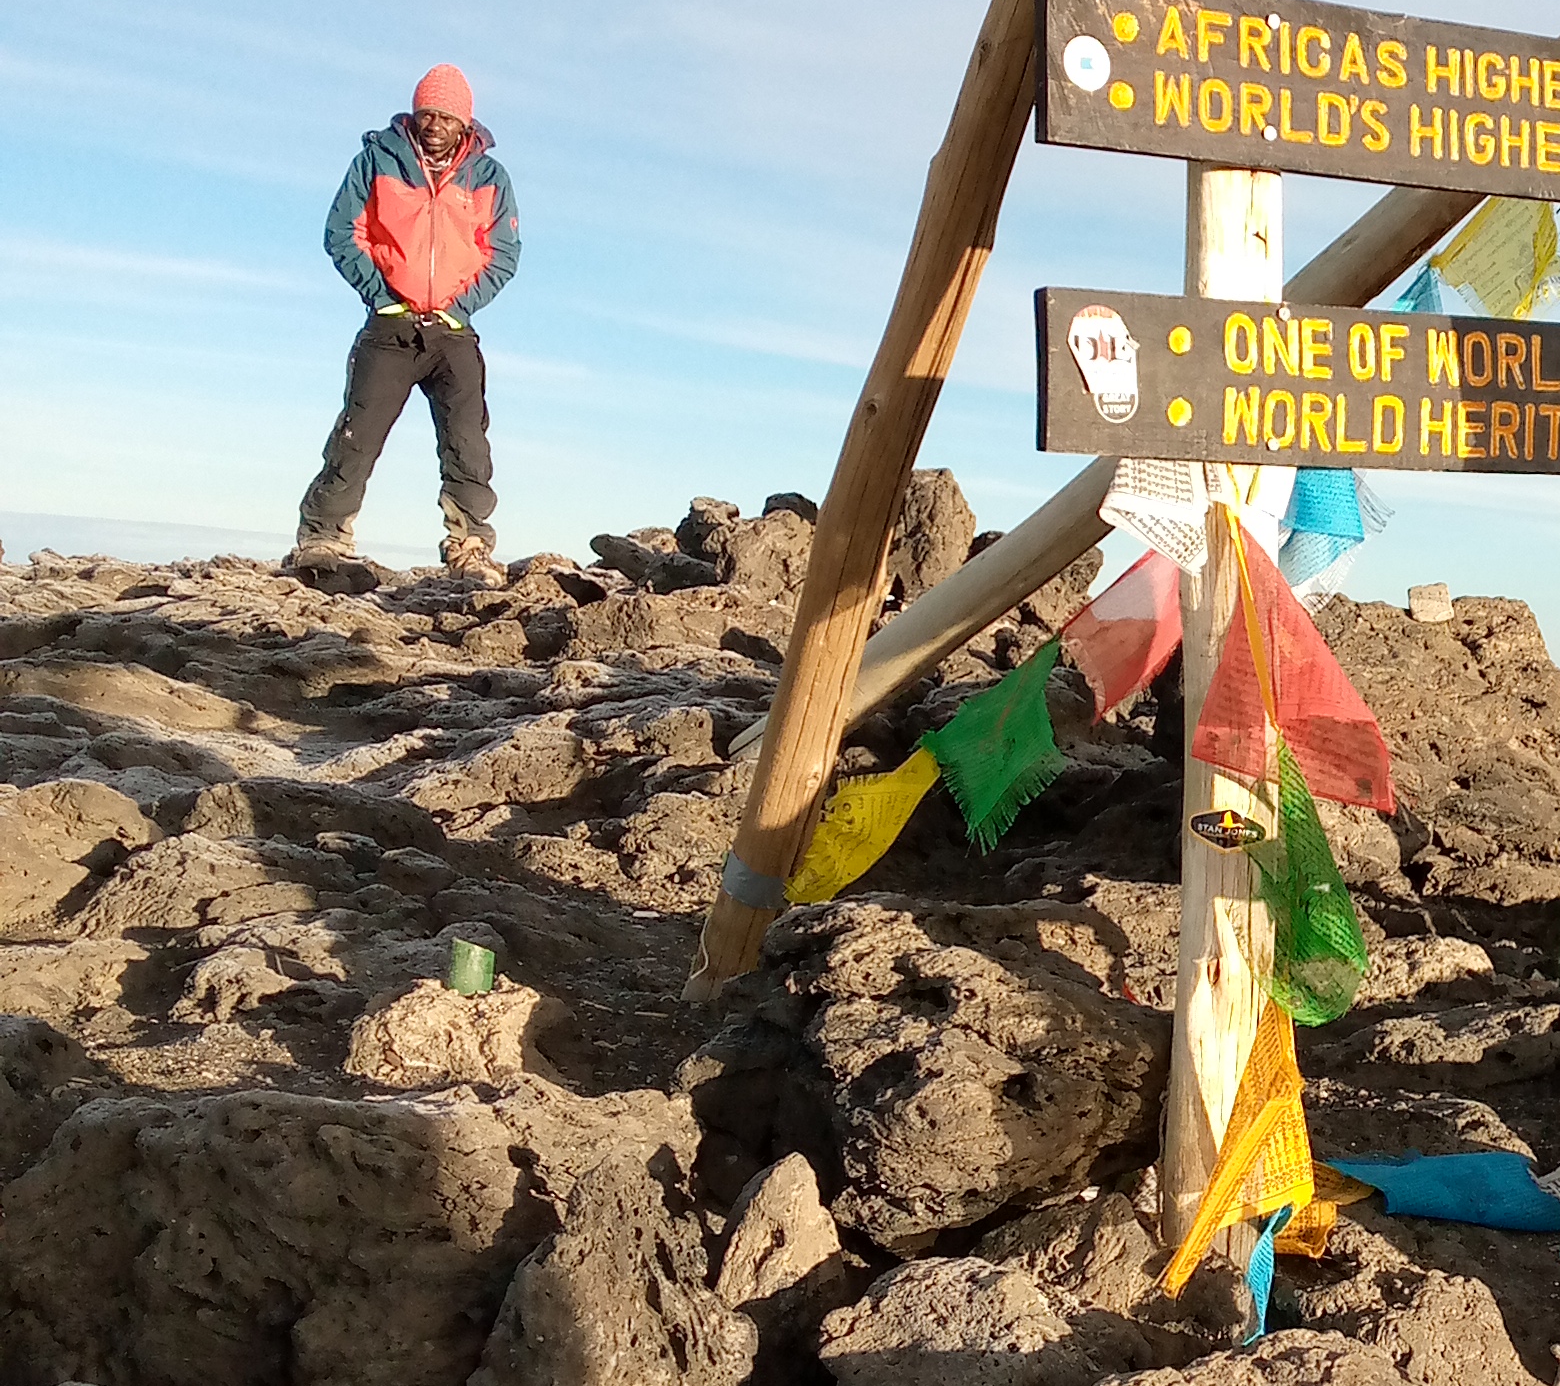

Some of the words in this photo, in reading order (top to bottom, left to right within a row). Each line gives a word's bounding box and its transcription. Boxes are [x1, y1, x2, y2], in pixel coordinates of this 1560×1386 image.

[1155, 4, 1408, 91] AFRICAS
[1152, 69, 1393, 155] WORLD'S
[1222, 310, 1333, 382] ONE
[1347, 321, 1410, 385] OF
[1222, 385, 1407, 457] WORLD
[1197, 823, 1223, 834] STAN
